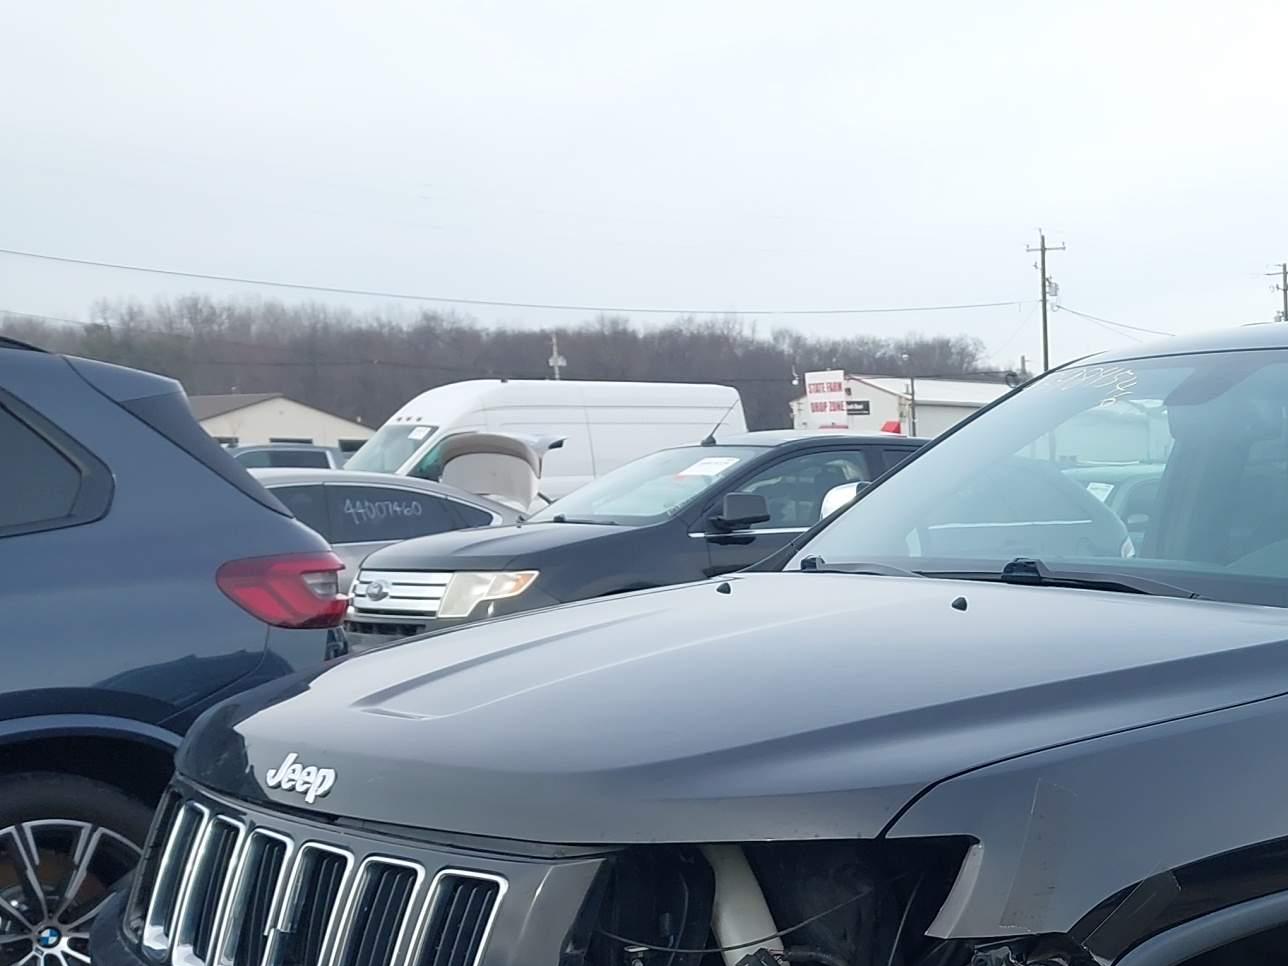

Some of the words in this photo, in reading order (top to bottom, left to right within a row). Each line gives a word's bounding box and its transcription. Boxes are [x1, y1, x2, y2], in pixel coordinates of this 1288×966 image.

[808, 383, 825, 394] STATE
[810, 401, 827, 413] DROP
[829, 400, 846, 412] ZONE
[344, 499, 422, 525] 44007460
[266, 752, 336, 804] Jeep
